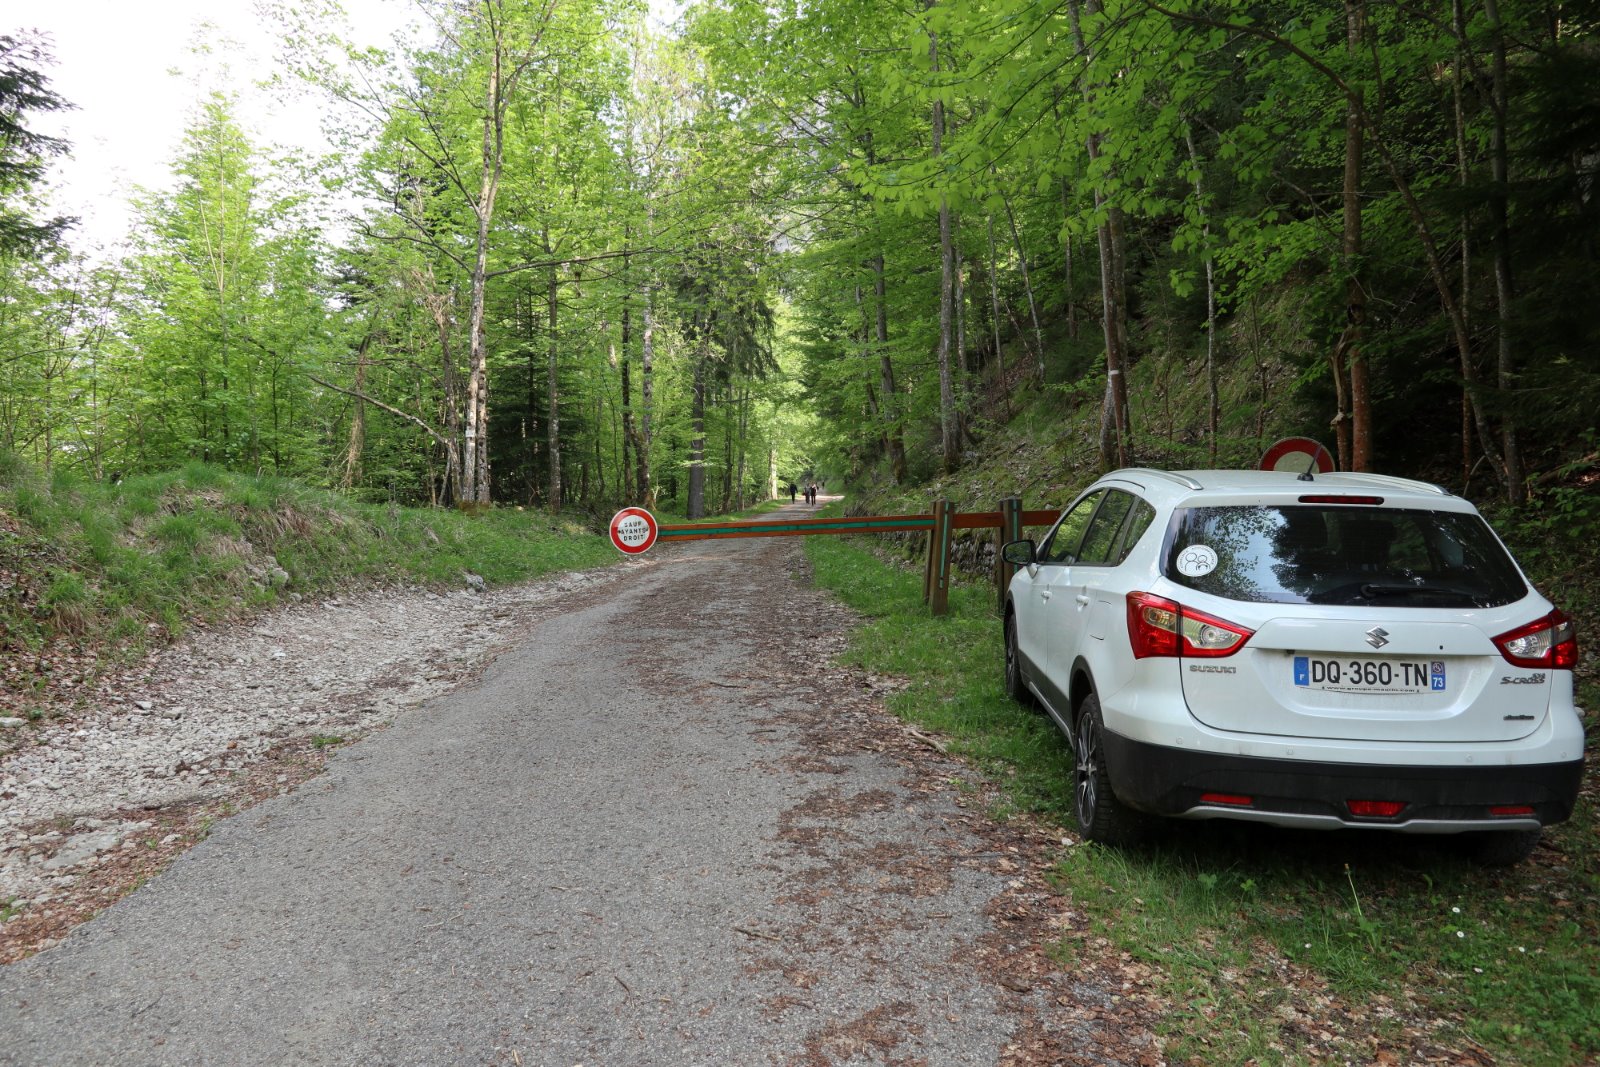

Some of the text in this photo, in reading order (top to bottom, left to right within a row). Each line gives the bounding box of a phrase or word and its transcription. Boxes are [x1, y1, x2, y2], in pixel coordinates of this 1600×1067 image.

[1190, 665, 1236, 673] SUZUKI
[1312, 660, 1427, 686] DQ-360-TN
[1433, 677, 1444, 688] 73
